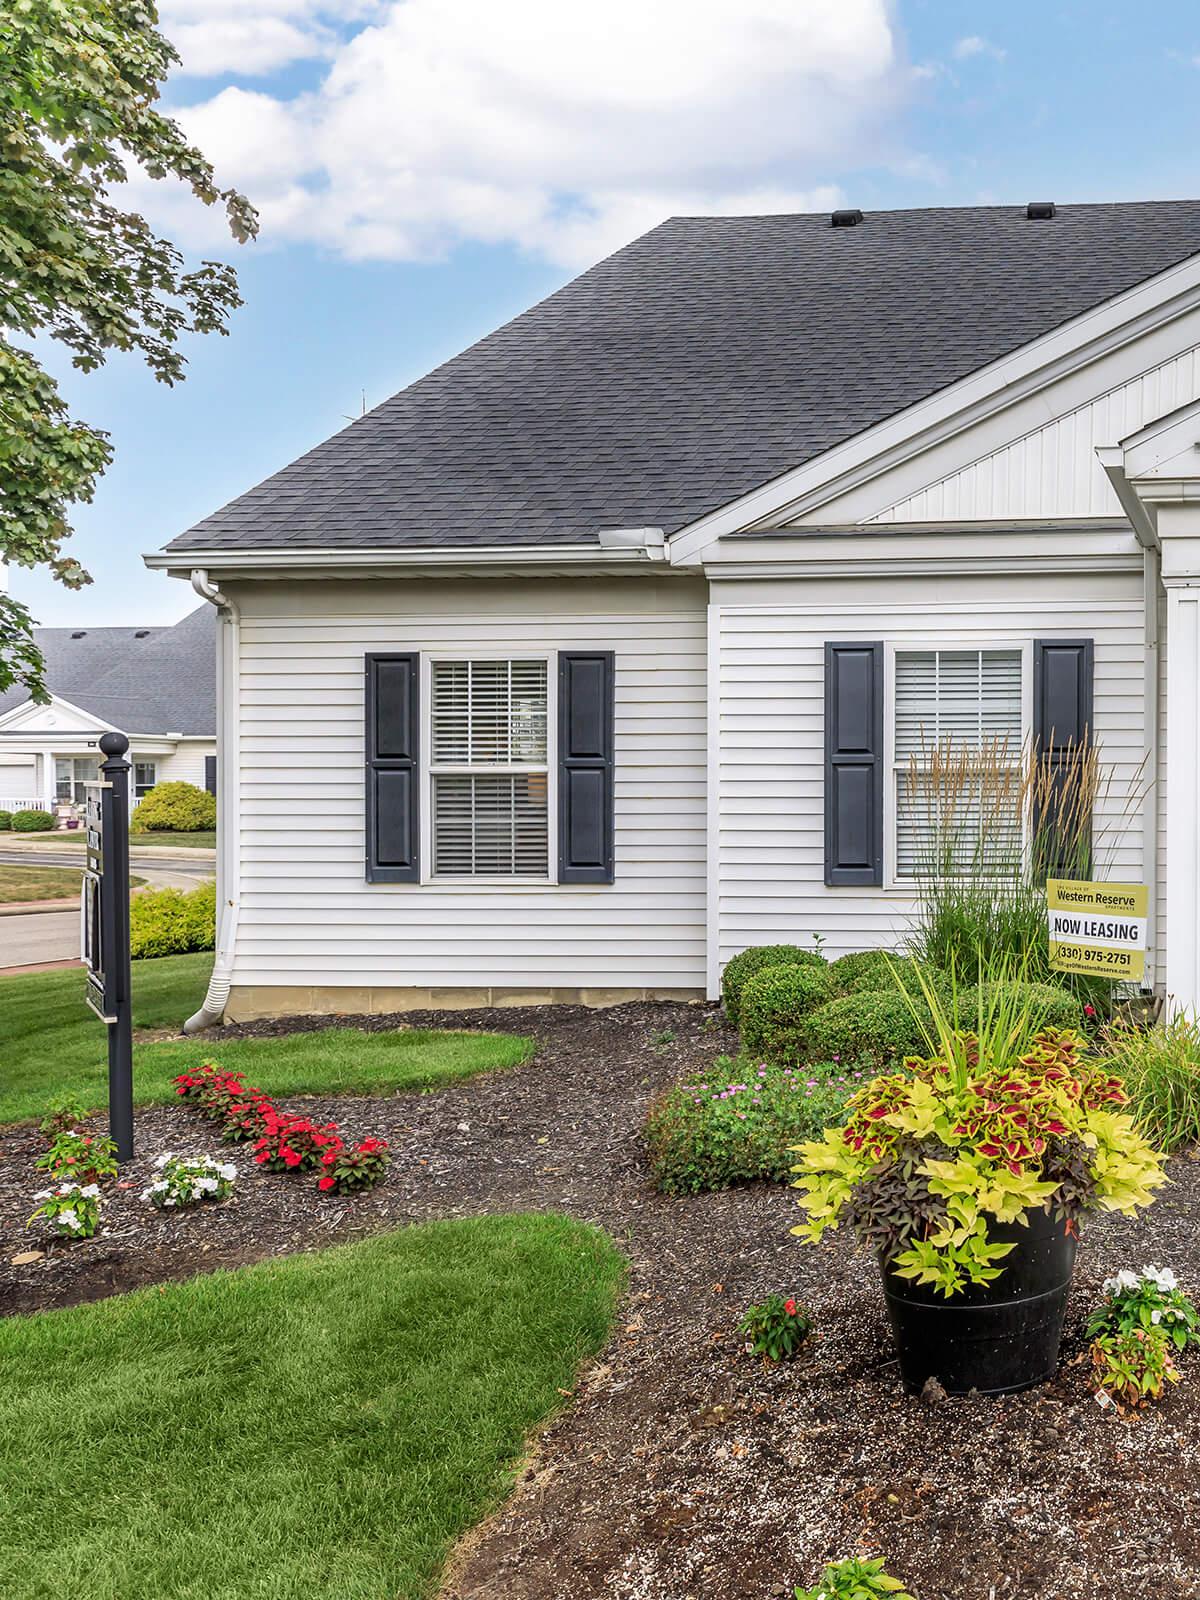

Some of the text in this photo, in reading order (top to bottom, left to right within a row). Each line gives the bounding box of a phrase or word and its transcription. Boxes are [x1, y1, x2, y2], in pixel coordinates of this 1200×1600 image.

[1057, 890, 1136, 906] Western Reserve
[1054, 917, 1138, 940] NOW LEASING
[1058, 945, 1131, 965] (330) 975-2751
